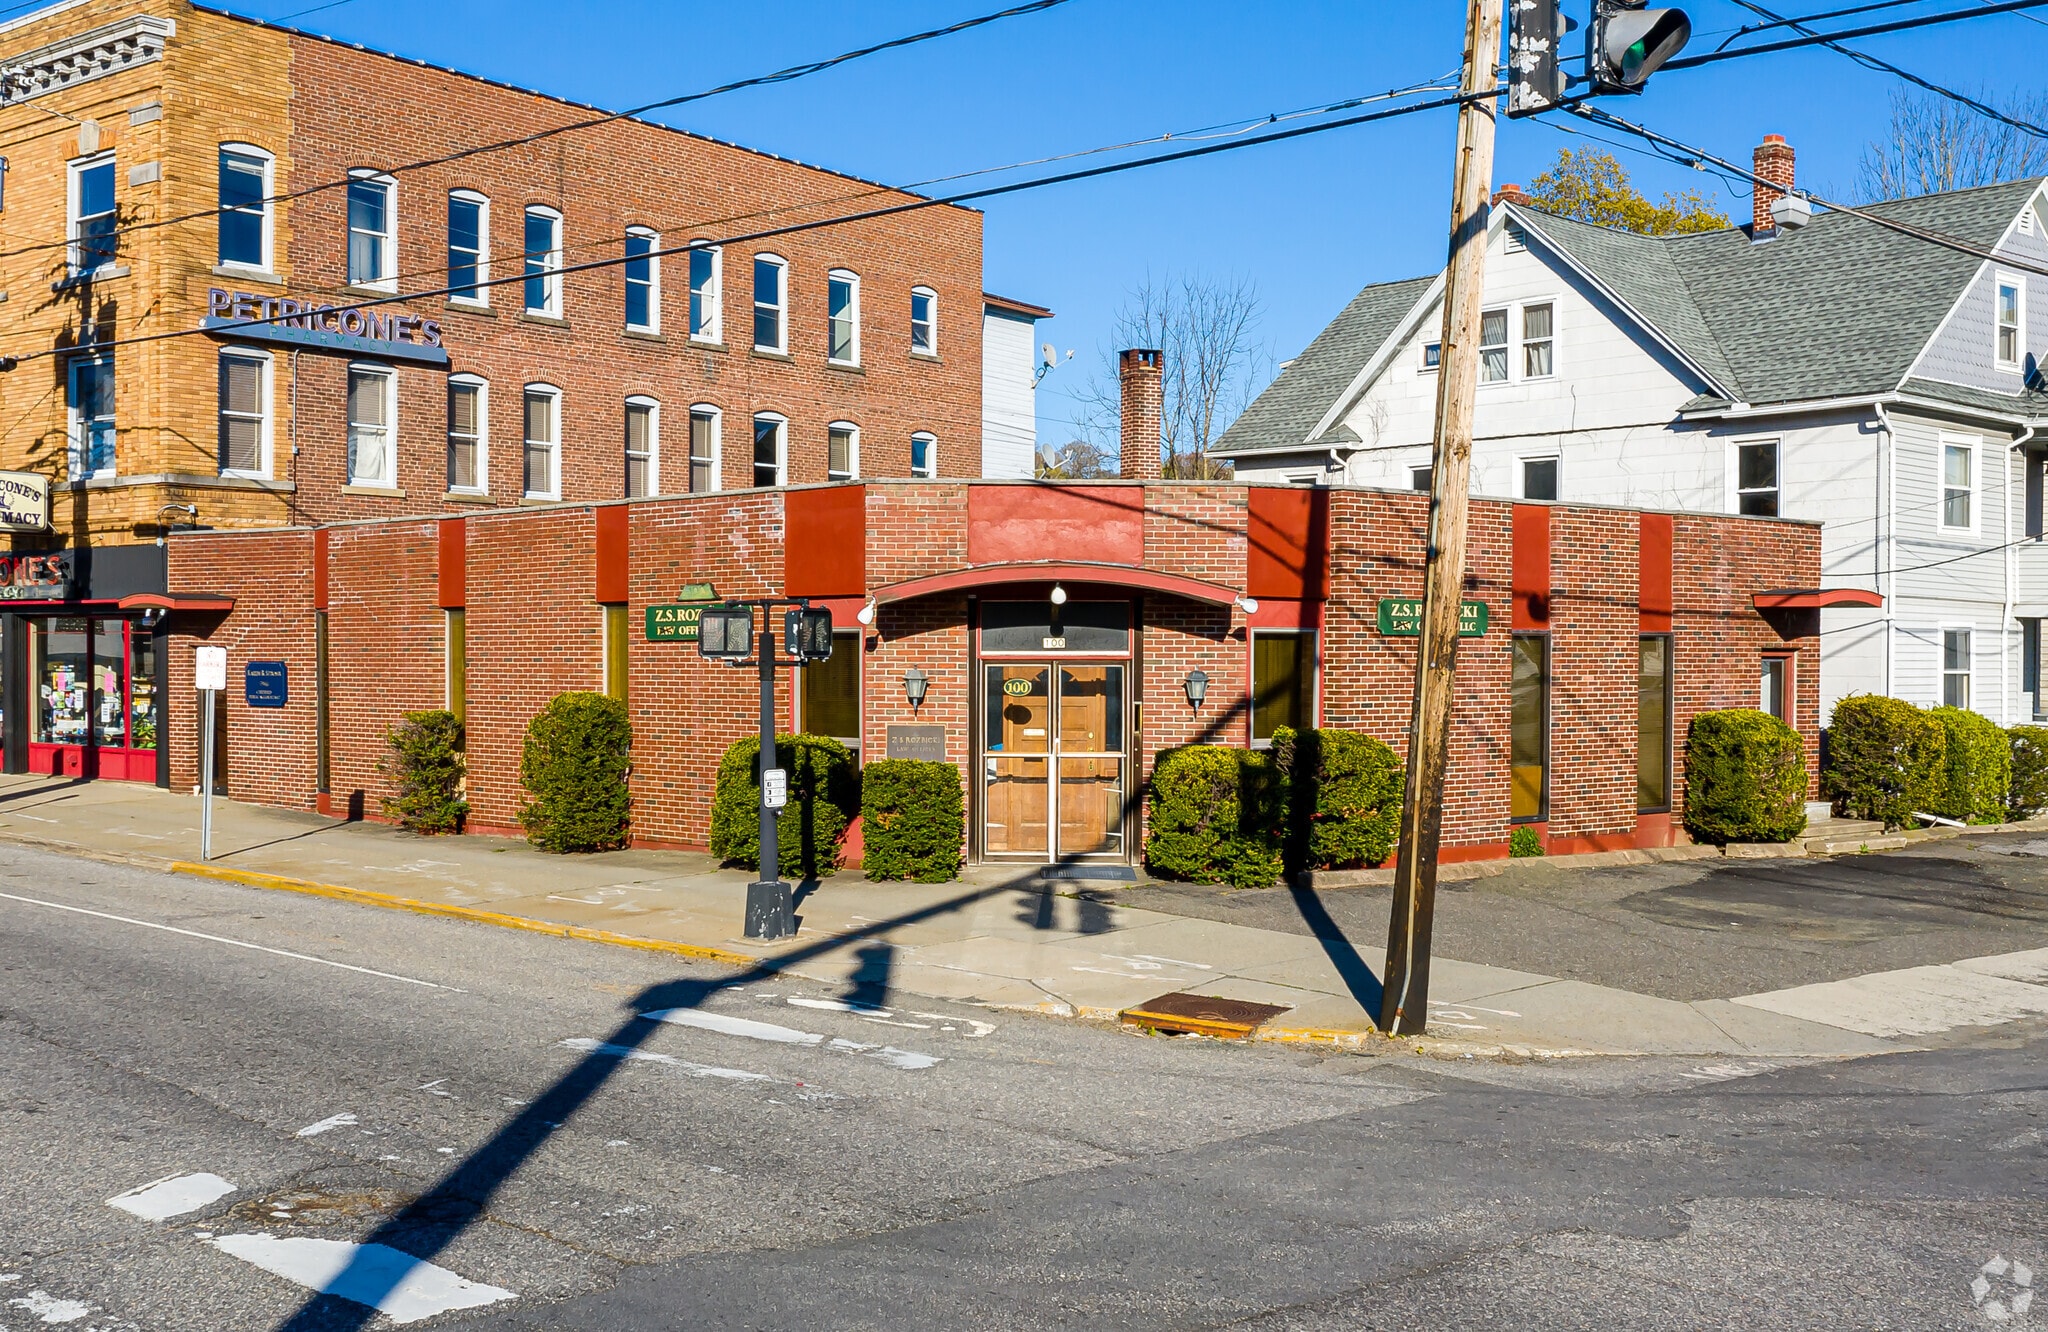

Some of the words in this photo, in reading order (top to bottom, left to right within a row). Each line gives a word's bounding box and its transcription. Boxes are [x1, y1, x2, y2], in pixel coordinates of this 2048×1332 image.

[208, 287, 441, 348] PETRICONE'S
[269, 325, 393, 352] PHARMACY
[655, 609, 676, 622] Z.S.
[1391, 603, 1413, 617] Z.S.
[1046, 638, 1065, 647] 100
[1007, 682, 1029, 693] 100
